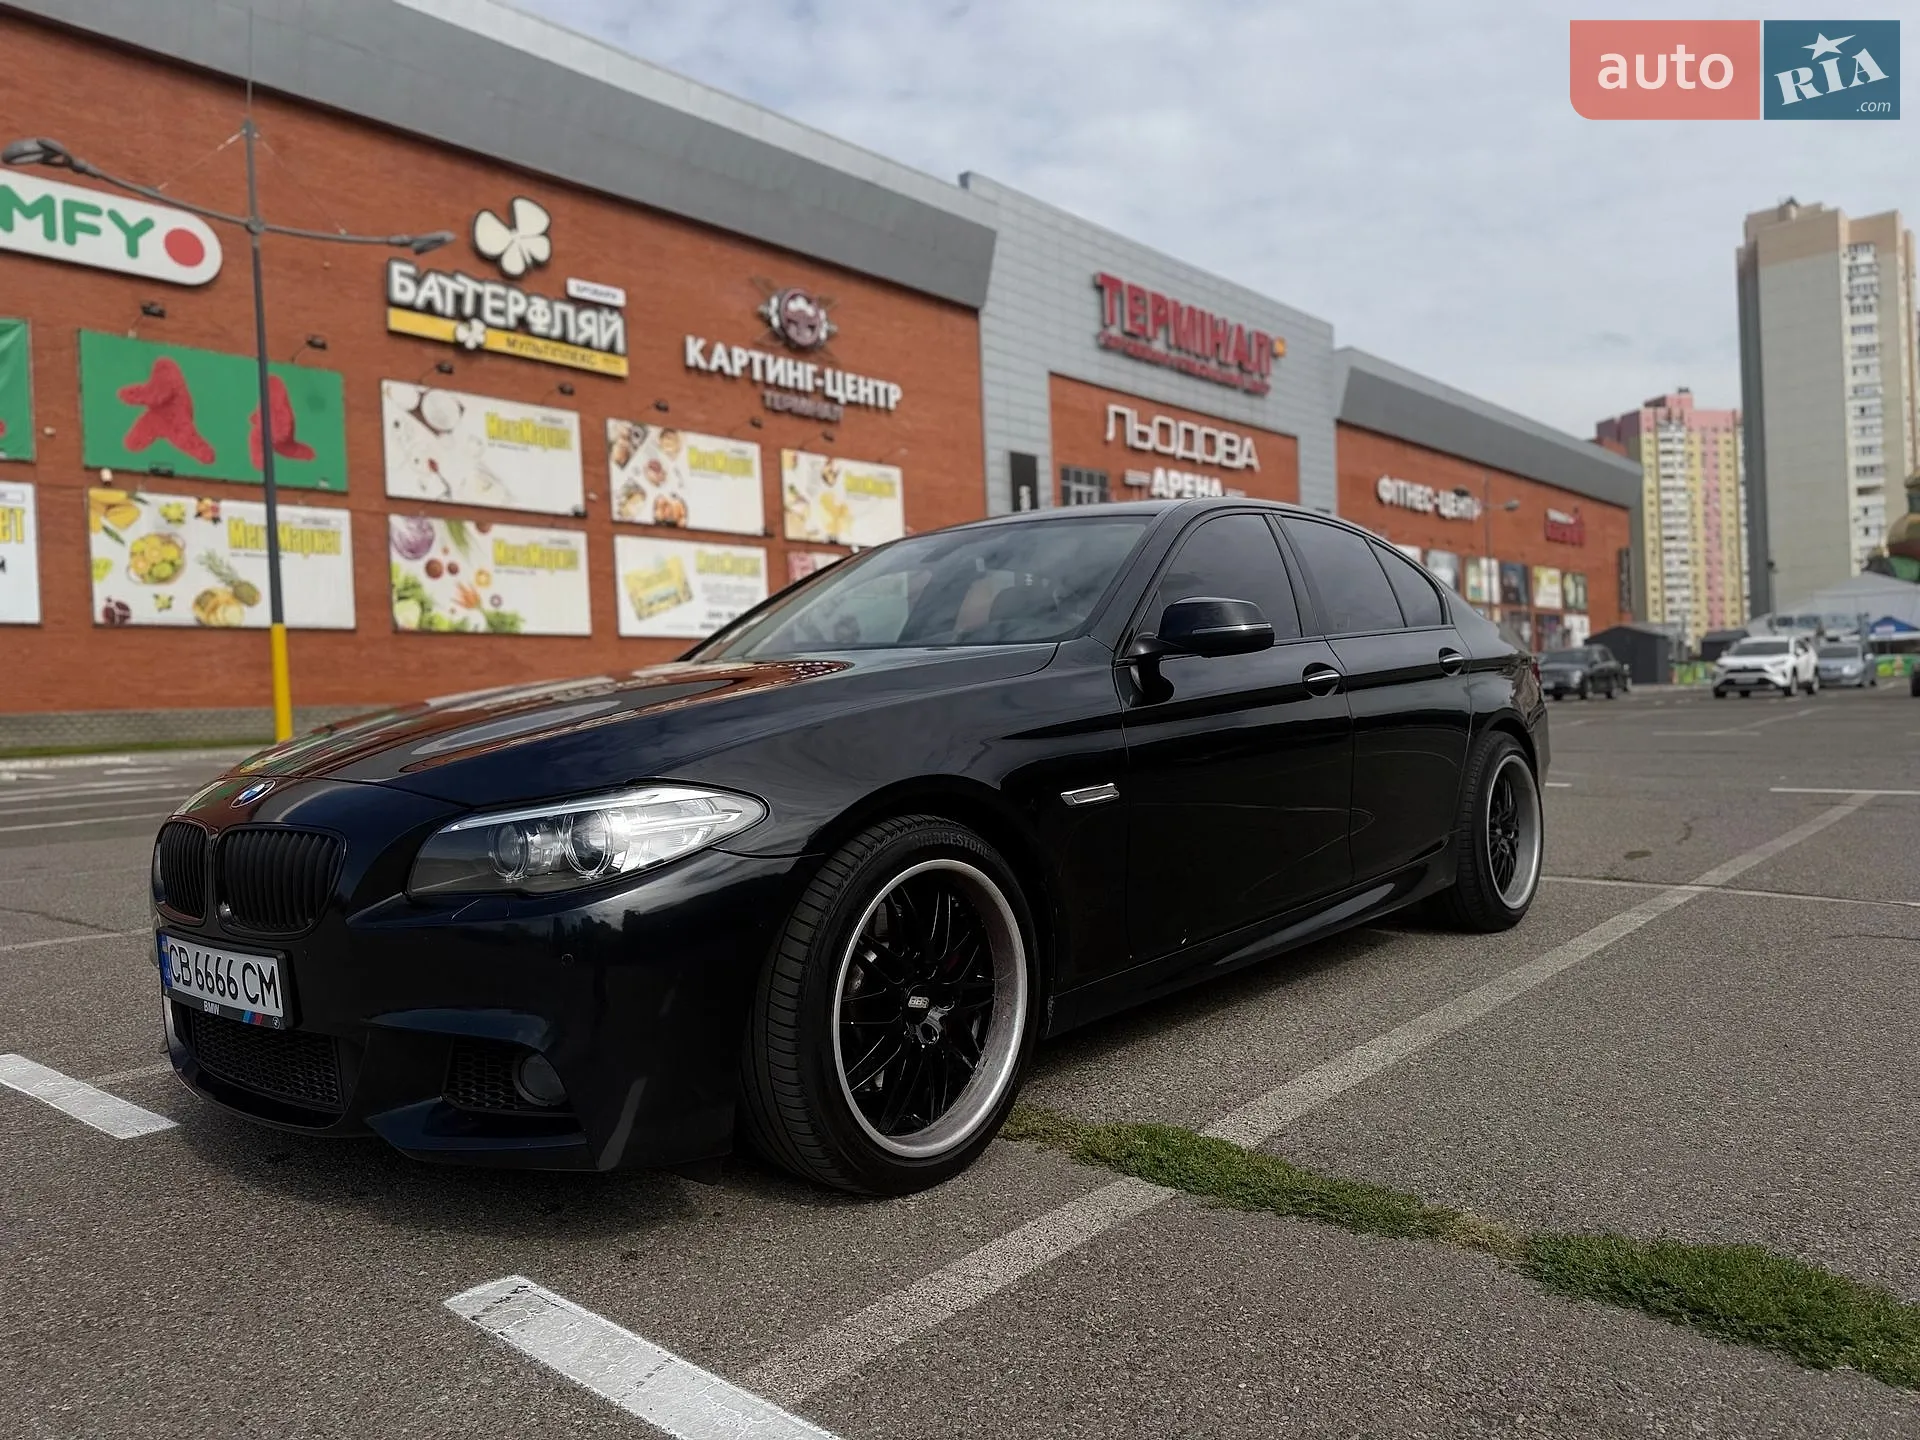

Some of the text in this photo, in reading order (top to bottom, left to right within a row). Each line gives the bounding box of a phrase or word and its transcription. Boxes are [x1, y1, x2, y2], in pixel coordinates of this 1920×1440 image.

[388, 260, 626, 354] БАТТЕРФЛЯЙ
[1094, 271, 1274, 376] ТЕРМІНАЛ
[685, 334, 903, 411] КАРТИНГ-ЦЕНТР
[1106, 403, 1261, 472] ЛЬОДОВА
[1151, 466, 1223, 498] АРЕНА
[169, 944, 192, 987] CB
[195, 951, 239, 1000] 6666
[242, 962, 280, 1009] CM
[203, 1000, 220, 1016] BMW
